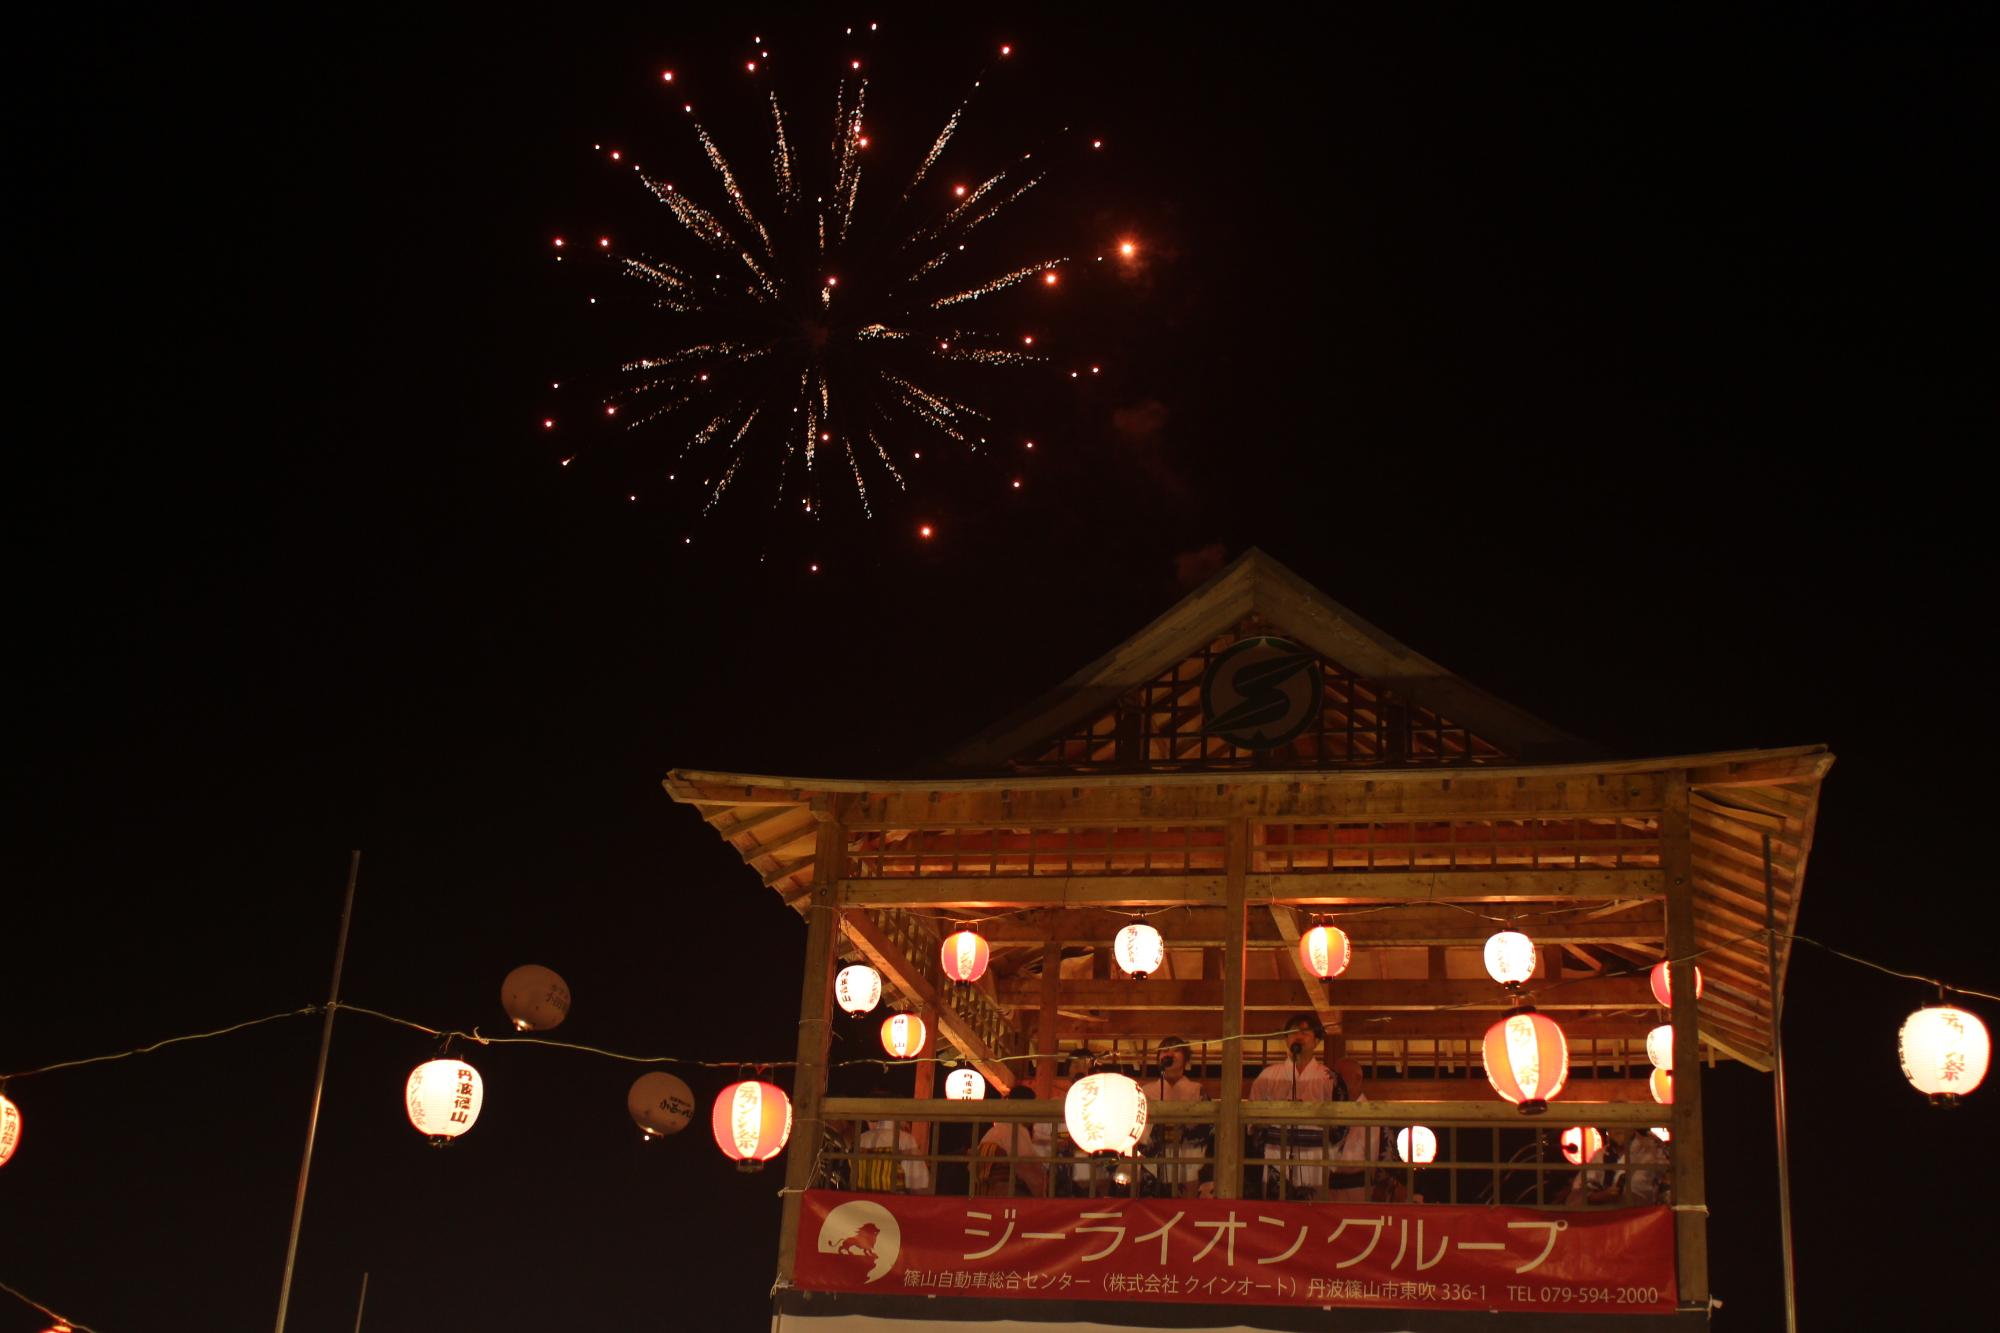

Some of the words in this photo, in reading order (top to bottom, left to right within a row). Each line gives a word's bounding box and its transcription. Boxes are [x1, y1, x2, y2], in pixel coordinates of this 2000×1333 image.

[1440, 1282, 1487, 1302] 336-1
[1506, 1284, 1537, 1303] TEL
[1540, 1286, 1659, 1305] 079-594-2000
